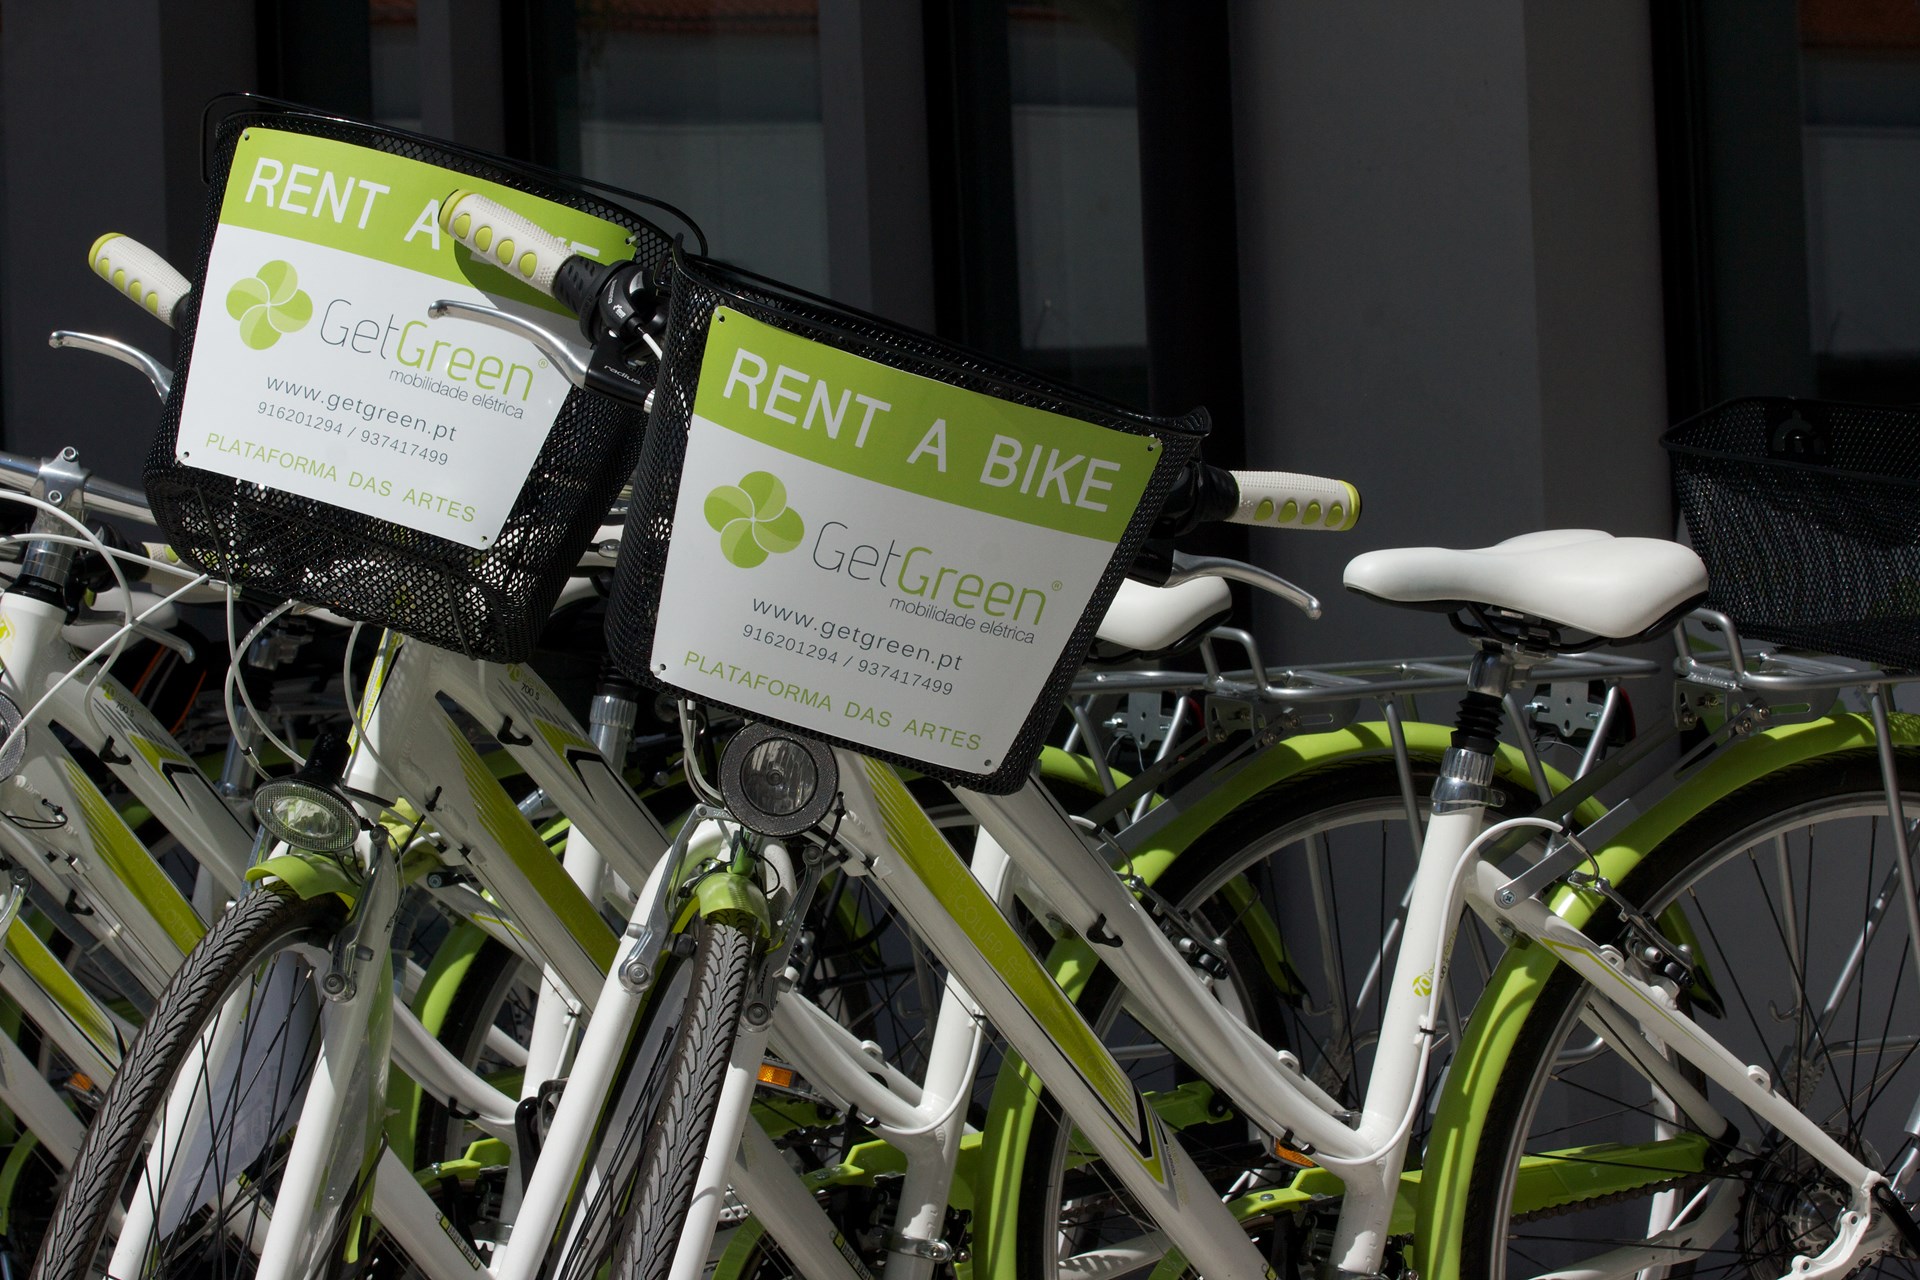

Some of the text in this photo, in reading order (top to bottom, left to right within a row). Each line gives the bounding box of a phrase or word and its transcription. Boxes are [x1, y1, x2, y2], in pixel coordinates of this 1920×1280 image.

[244, 156, 440, 250] RENT A
[320, 298, 534, 402] GetGreen
[604, 364, 641, 386] radius
[266, 375, 458, 442] www.getgreen.pt
[389, 367, 524, 420] mobilidade elétrica
[722, 347, 1122, 513] RENT A BIKE
[256, 401, 449, 466] 916201294 / 937417499
[205, 432, 477, 524] PLATAFORMA DAS ARTES
[812, 521, 1047, 626] GetGreen
[752, 597, 964, 672] www.getgreen.pt
[889, 597, 1035, 645] mobilidade elétrica
[742, 623, 954, 696] 916201294 / 937417499
[683, 650, 982, 752] PLATAFORMA DAS ARTES
